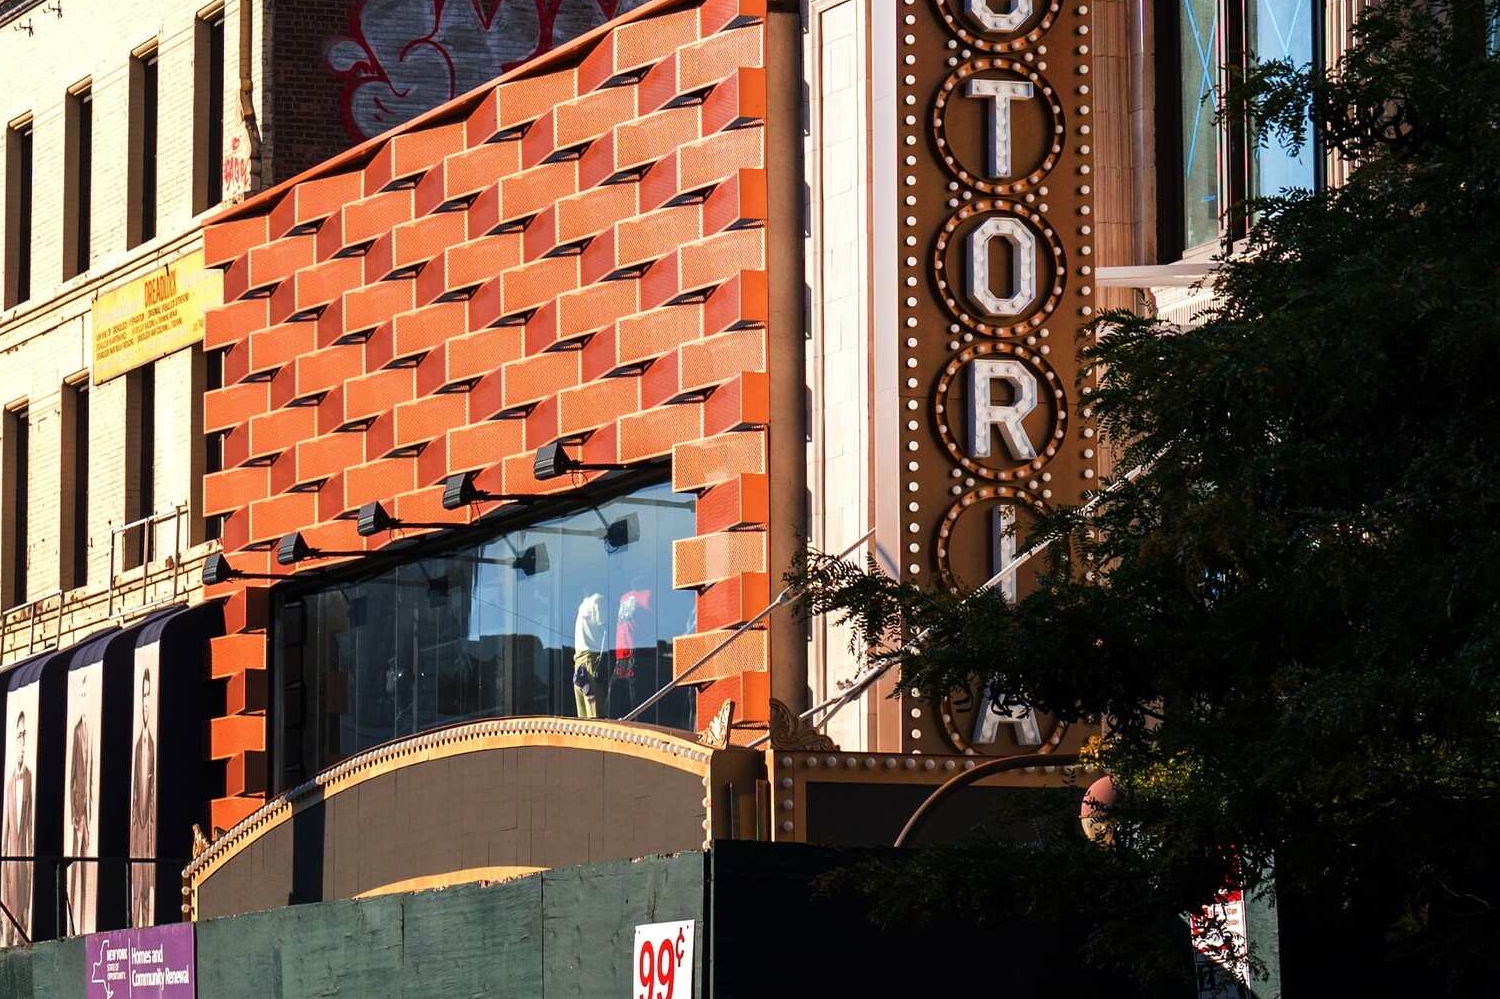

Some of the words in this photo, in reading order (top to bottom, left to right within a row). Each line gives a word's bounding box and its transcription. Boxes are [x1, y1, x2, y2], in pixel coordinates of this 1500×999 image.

[132, 948, 152, 965] Homes
[152, 944, 164, 963] and
[132, 967, 165, 991] Community
[165, 964, 189, 985] Renewal
